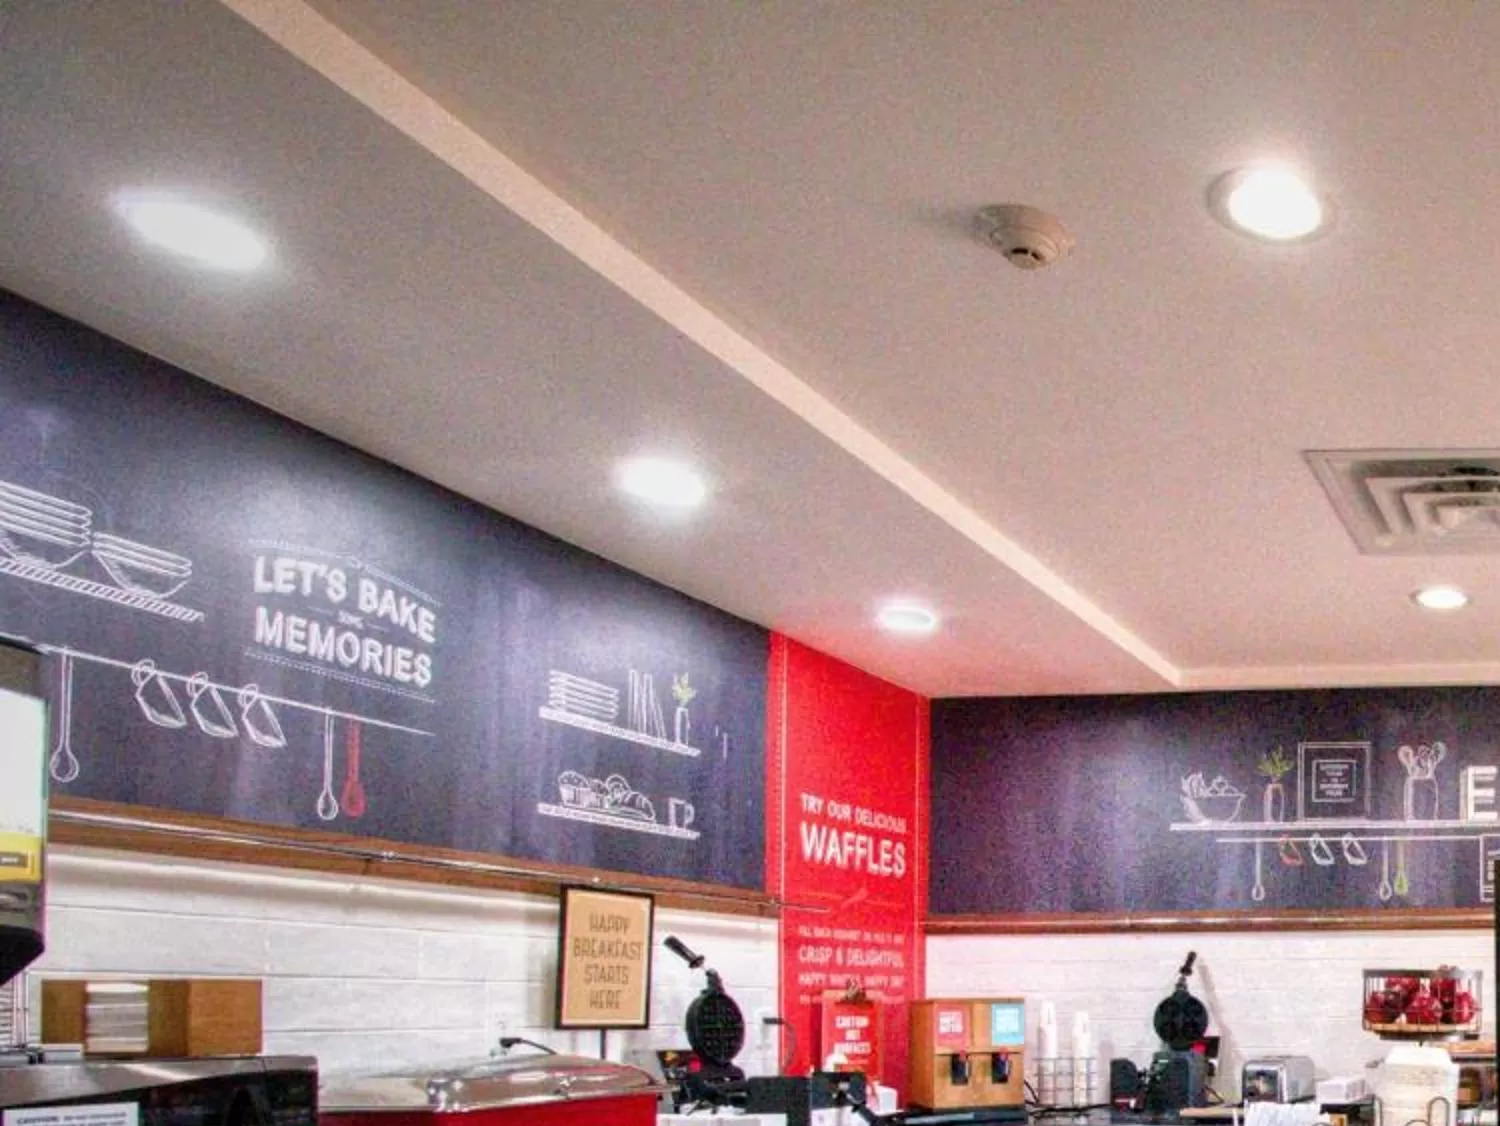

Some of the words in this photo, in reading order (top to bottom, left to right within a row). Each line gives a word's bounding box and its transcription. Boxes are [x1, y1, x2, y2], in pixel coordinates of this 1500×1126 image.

[253, 554, 348, 605] LET'S
[358, 576, 437, 644] BAKE
[253, 604, 433, 689] MEMORIES
[801, 792, 824, 815] TRY
[827, 799, 852, 821] OUR
[800, 819, 906, 879] WAFFLES
[588, 911, 632, 934] HAPPY
[573, 935, 645, 961] BREAKFAST
[798, 944, 833, 965] CRISP
[583, 963, 629, 986] STARTS
[588, 988, 622, 1010] HERE
